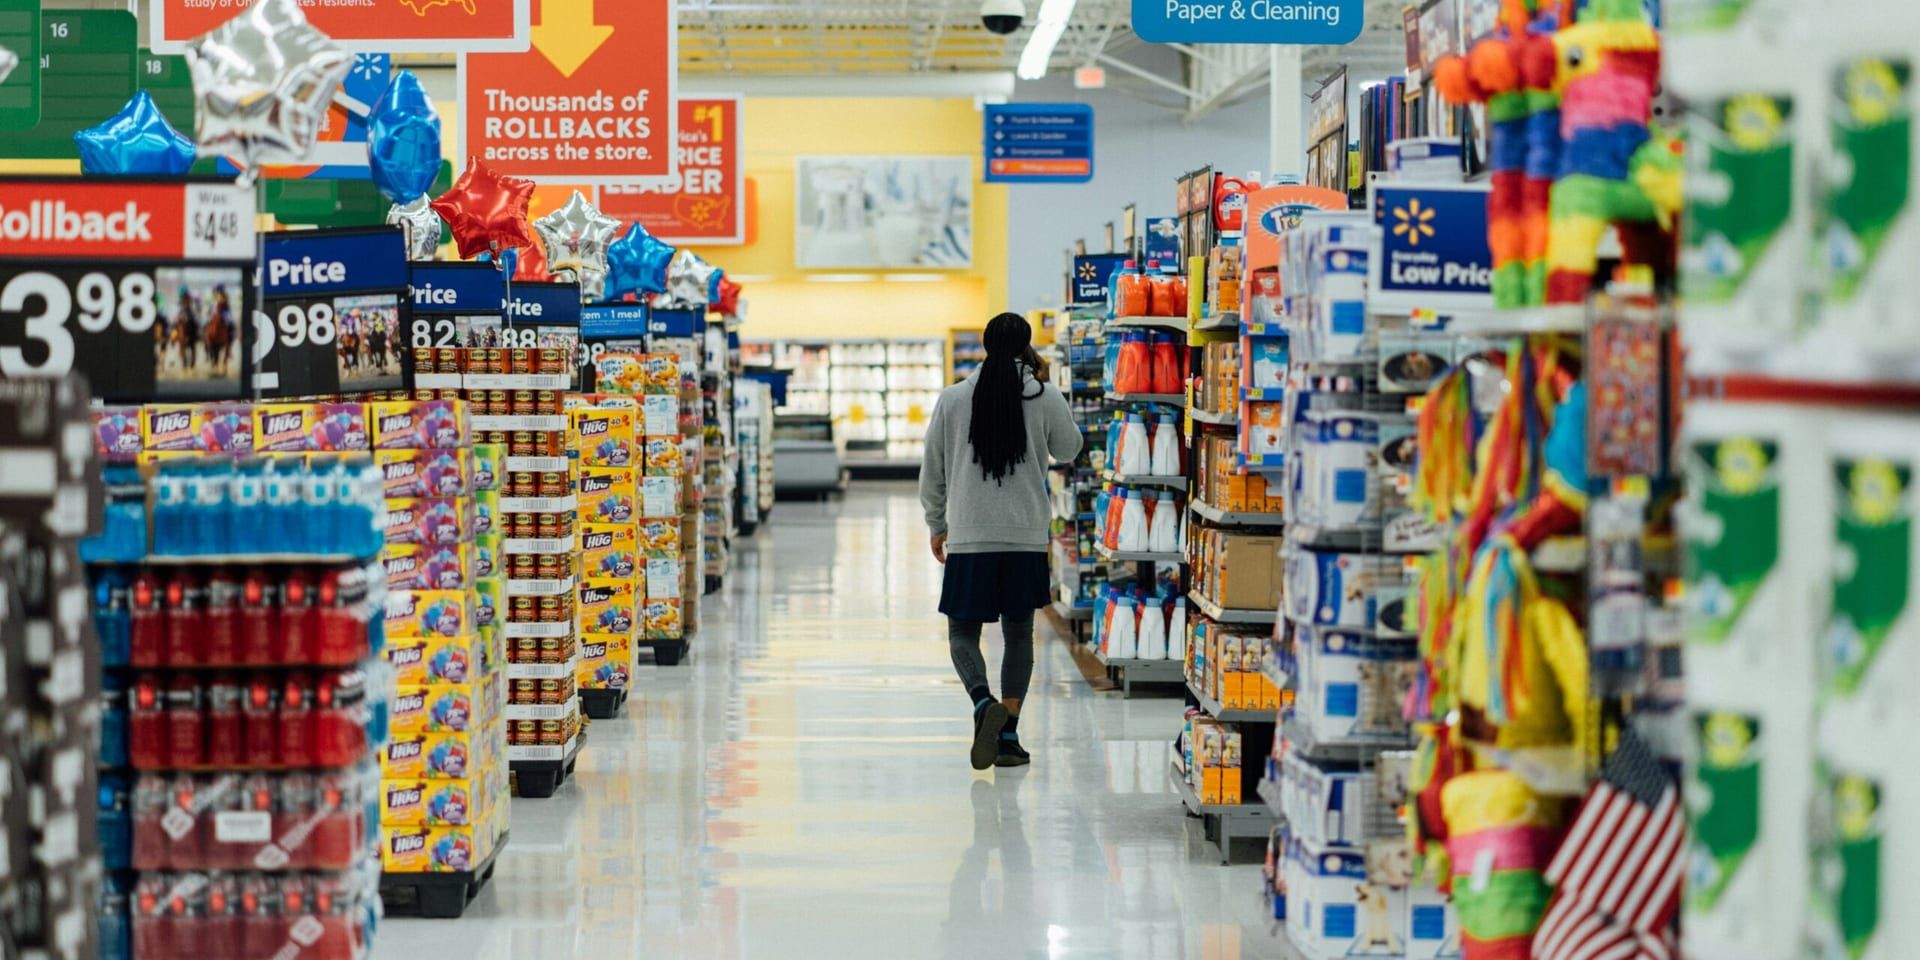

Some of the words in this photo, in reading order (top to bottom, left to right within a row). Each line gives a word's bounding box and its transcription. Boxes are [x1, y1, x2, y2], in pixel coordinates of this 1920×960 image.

[1166, 0, 1227, 25] Paper
[1230, 0, 1246, 20] &
[1251, 0, 1340, 26] Cleaning
[50, 23, 69, 38] 16
[146, 60, 162, 74] 18
[484, 89, 615, 113] Thousands
[621, 89, 650, 113] of
[484, 117, 651, 140] ROLLBACKS
[693, 104, 723, 143] #1
[484, 145, 550, 161] across
[555, 142, 590, 161] the
[595, 143, 653, 161] store.
[268, 255, 347, 287] Price
[1391, 261, 1441, 285] Low
[1443, 261, 1492, 286] Pric
[1080, 287, 1101, 297] Low
[610, 309, 615, 319] 1
[617, 309, 641, 319] meal
[412, 319, 456, 348] 82
[156, 414, 190, 434] HUG
[268, 414, 301, 435] HUG
[383, 415, 412, 433] HUG
[582, 421, 607, 435] HUG
[586, 535, 611, 548] HUG
[615, 531, 625, 539] 40
[583, 645, 605, 658] HUG
[391, 743, 420, 760] HUG
[391, 790, 420, 808] HUG
[394, 836, 424, 854] HUG
